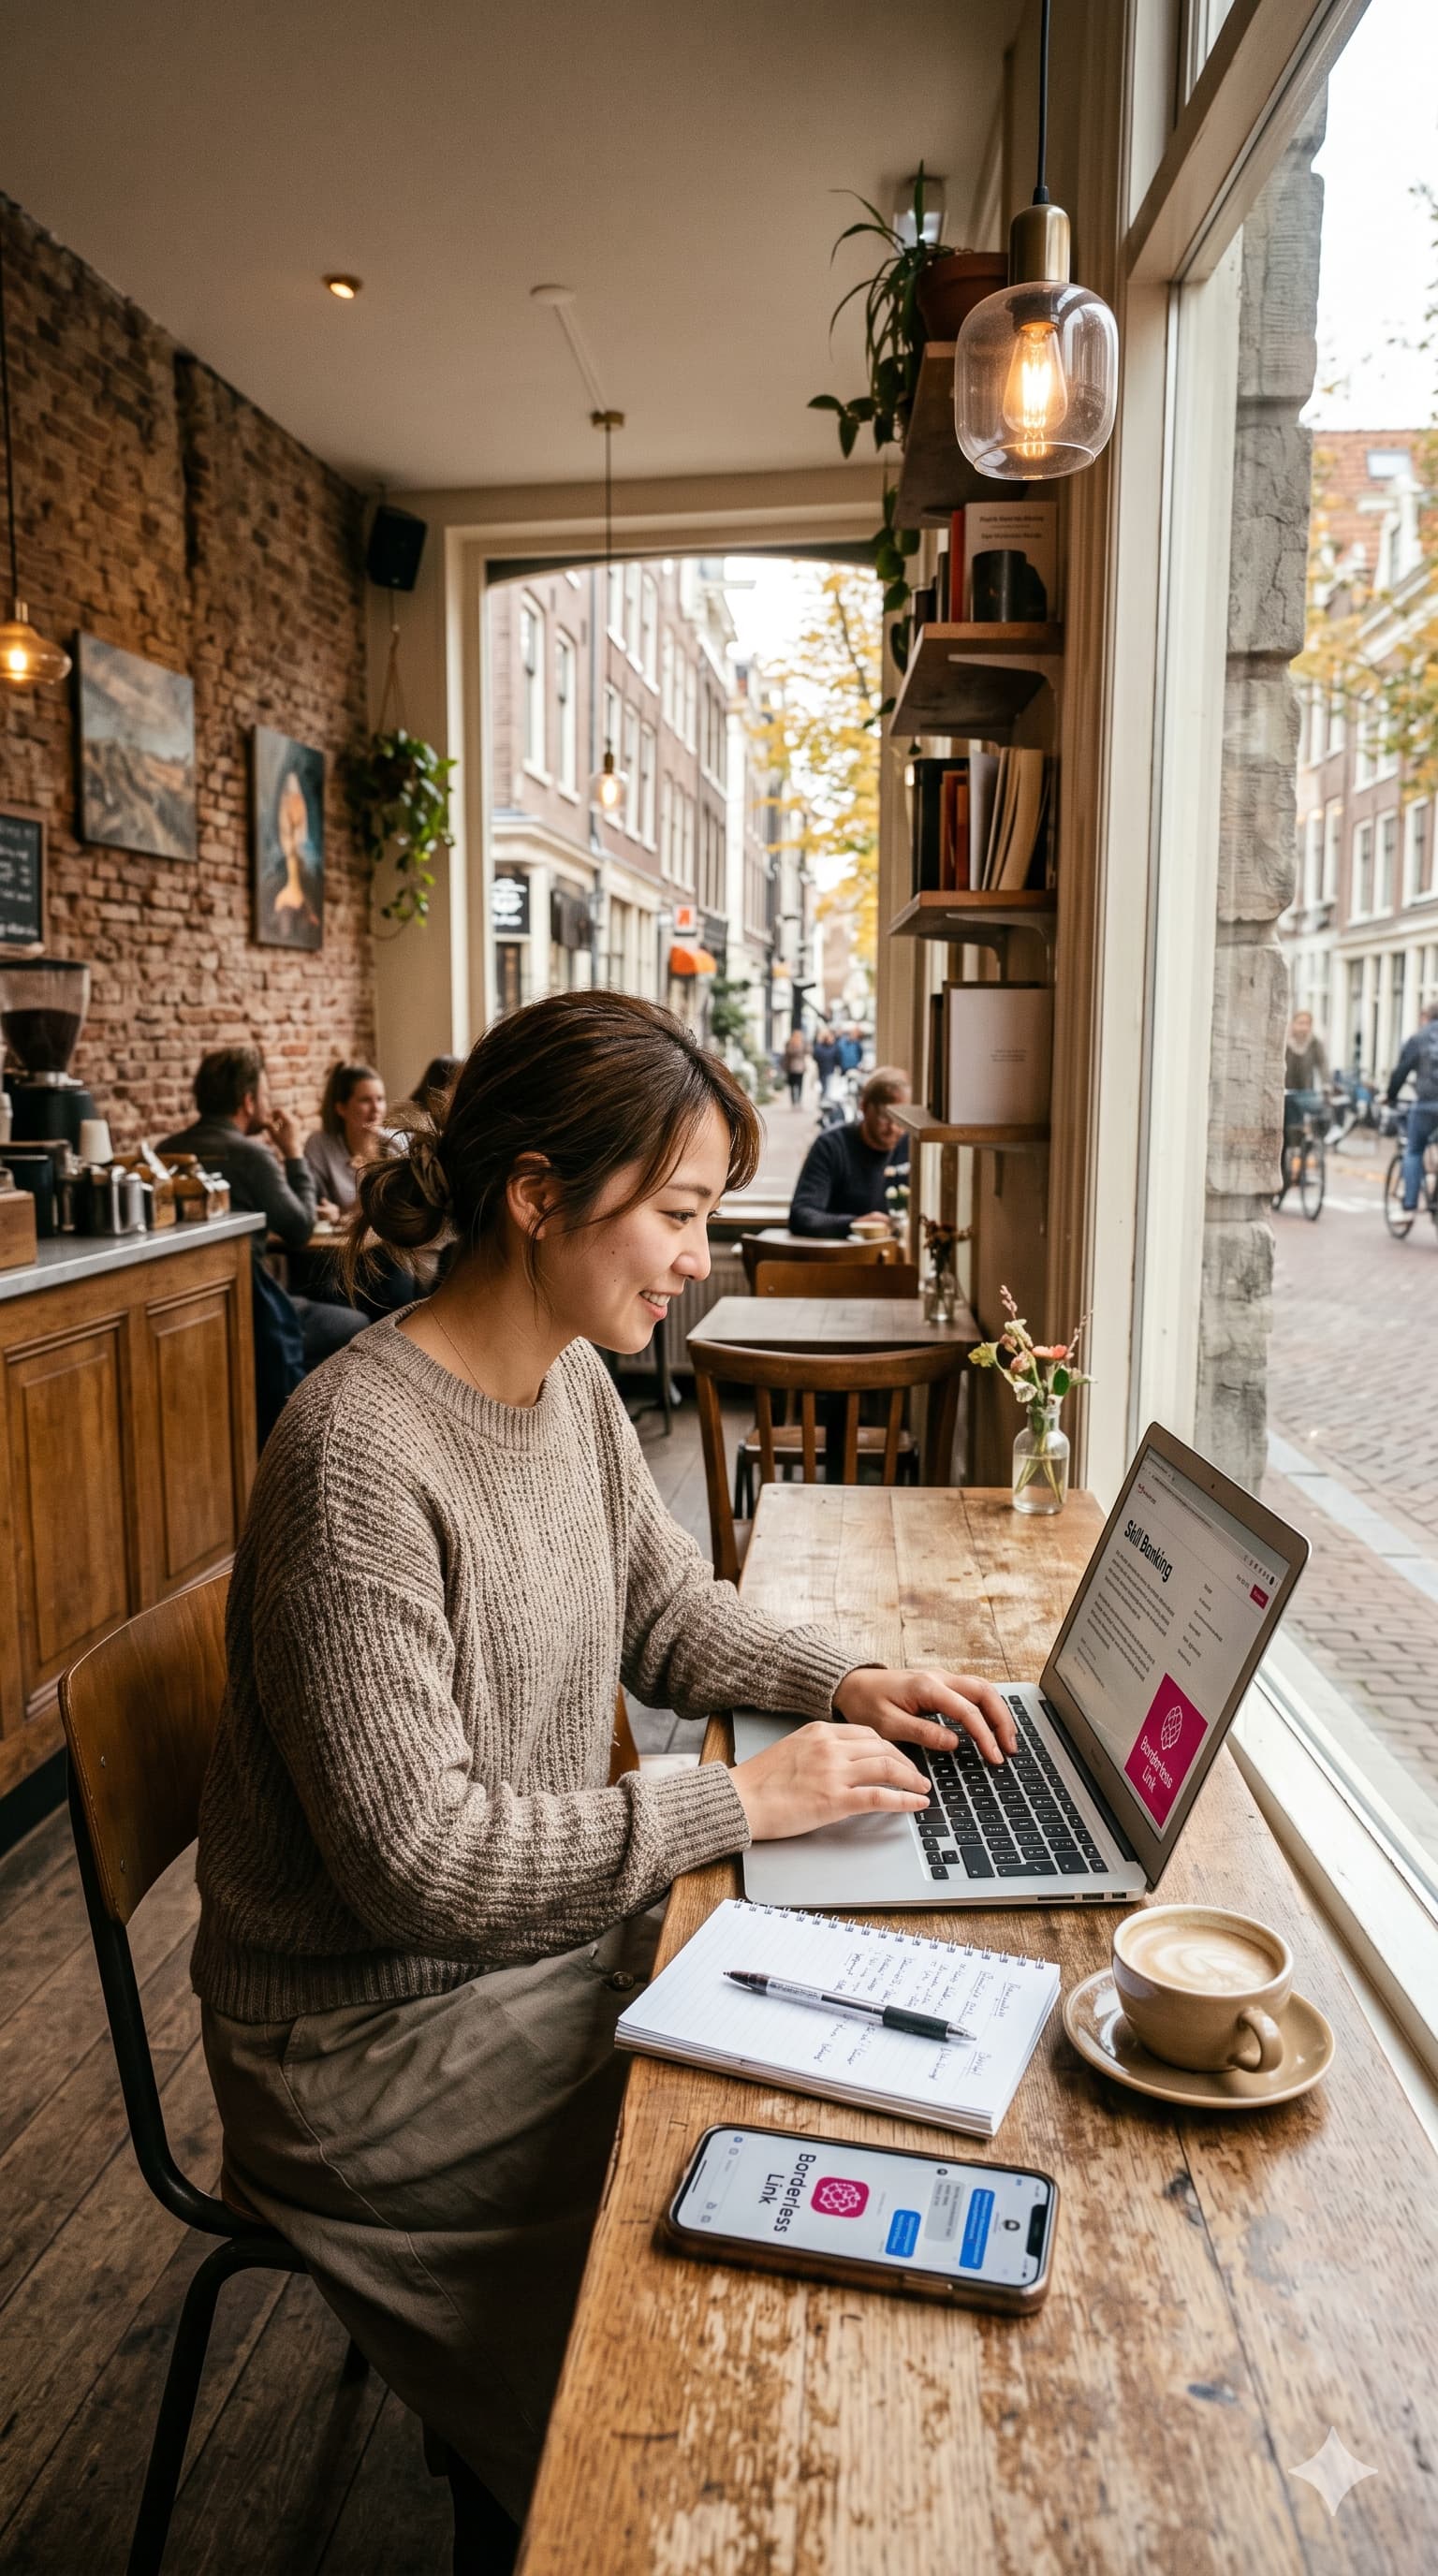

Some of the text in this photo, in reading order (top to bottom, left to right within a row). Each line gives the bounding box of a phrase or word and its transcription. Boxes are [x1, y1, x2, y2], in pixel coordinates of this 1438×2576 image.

[1139, 1533, 1173, 1583] Banking
[758, 2174, 785, 2204] Link
[773, 2153, 817, 2232] Borderless
